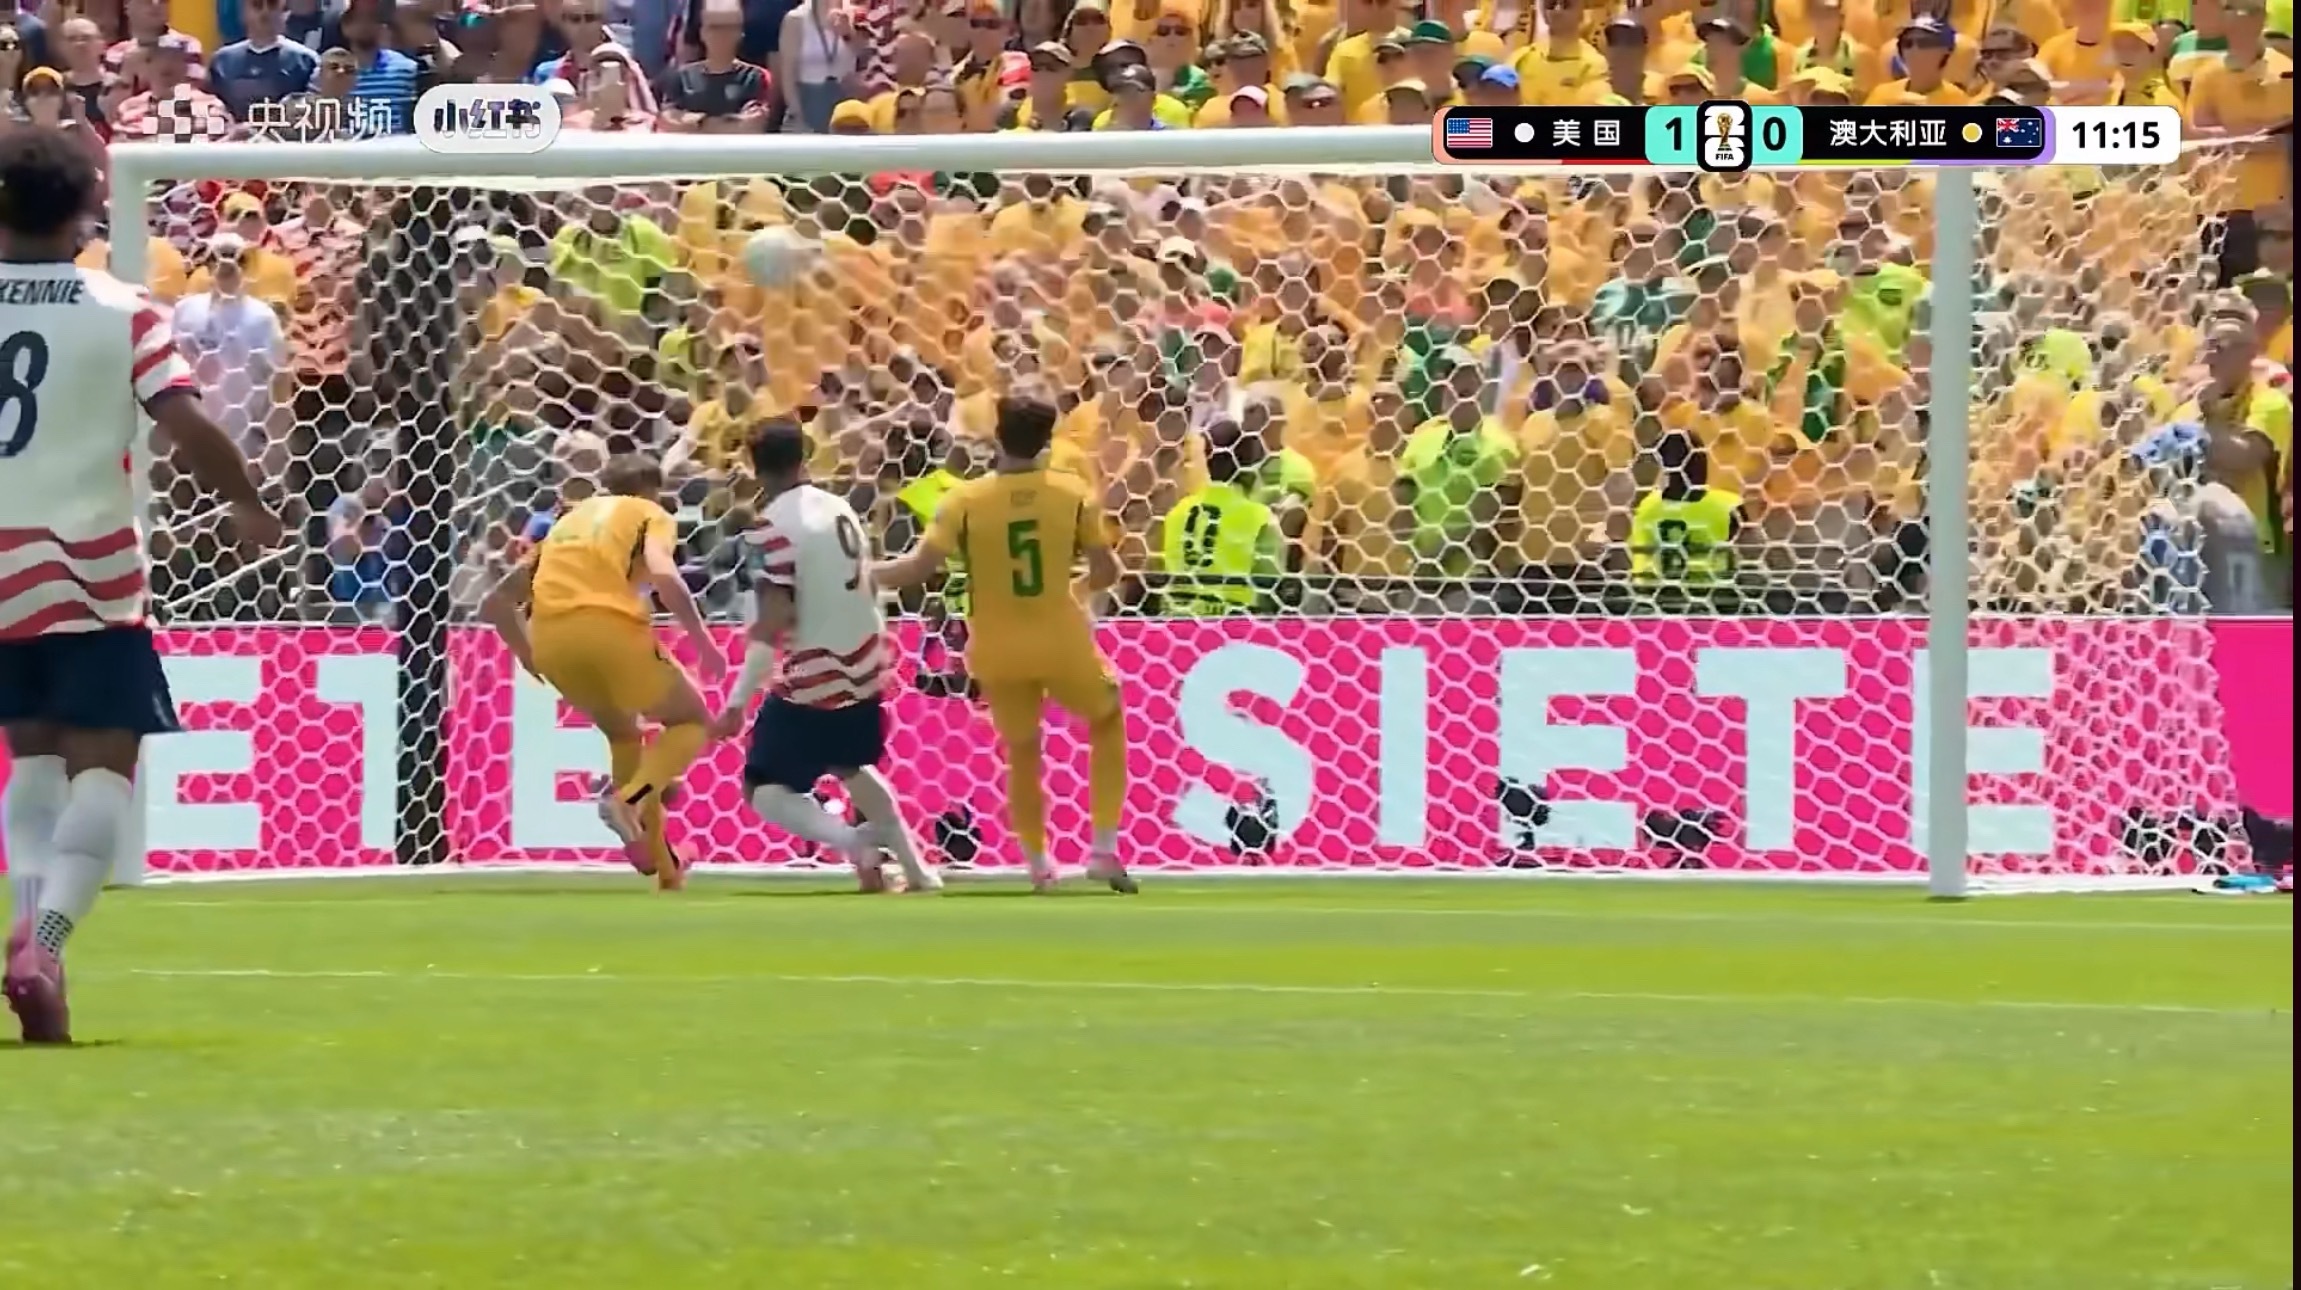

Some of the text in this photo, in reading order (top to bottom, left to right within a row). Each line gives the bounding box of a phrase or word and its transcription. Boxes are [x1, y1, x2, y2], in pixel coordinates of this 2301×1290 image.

[0, 330, 49, 456] 8
[836, 514, 860, 591] 9
[1008, 519, 1043, 597] 5
[1174, 642, 2054, 855] SIETE
